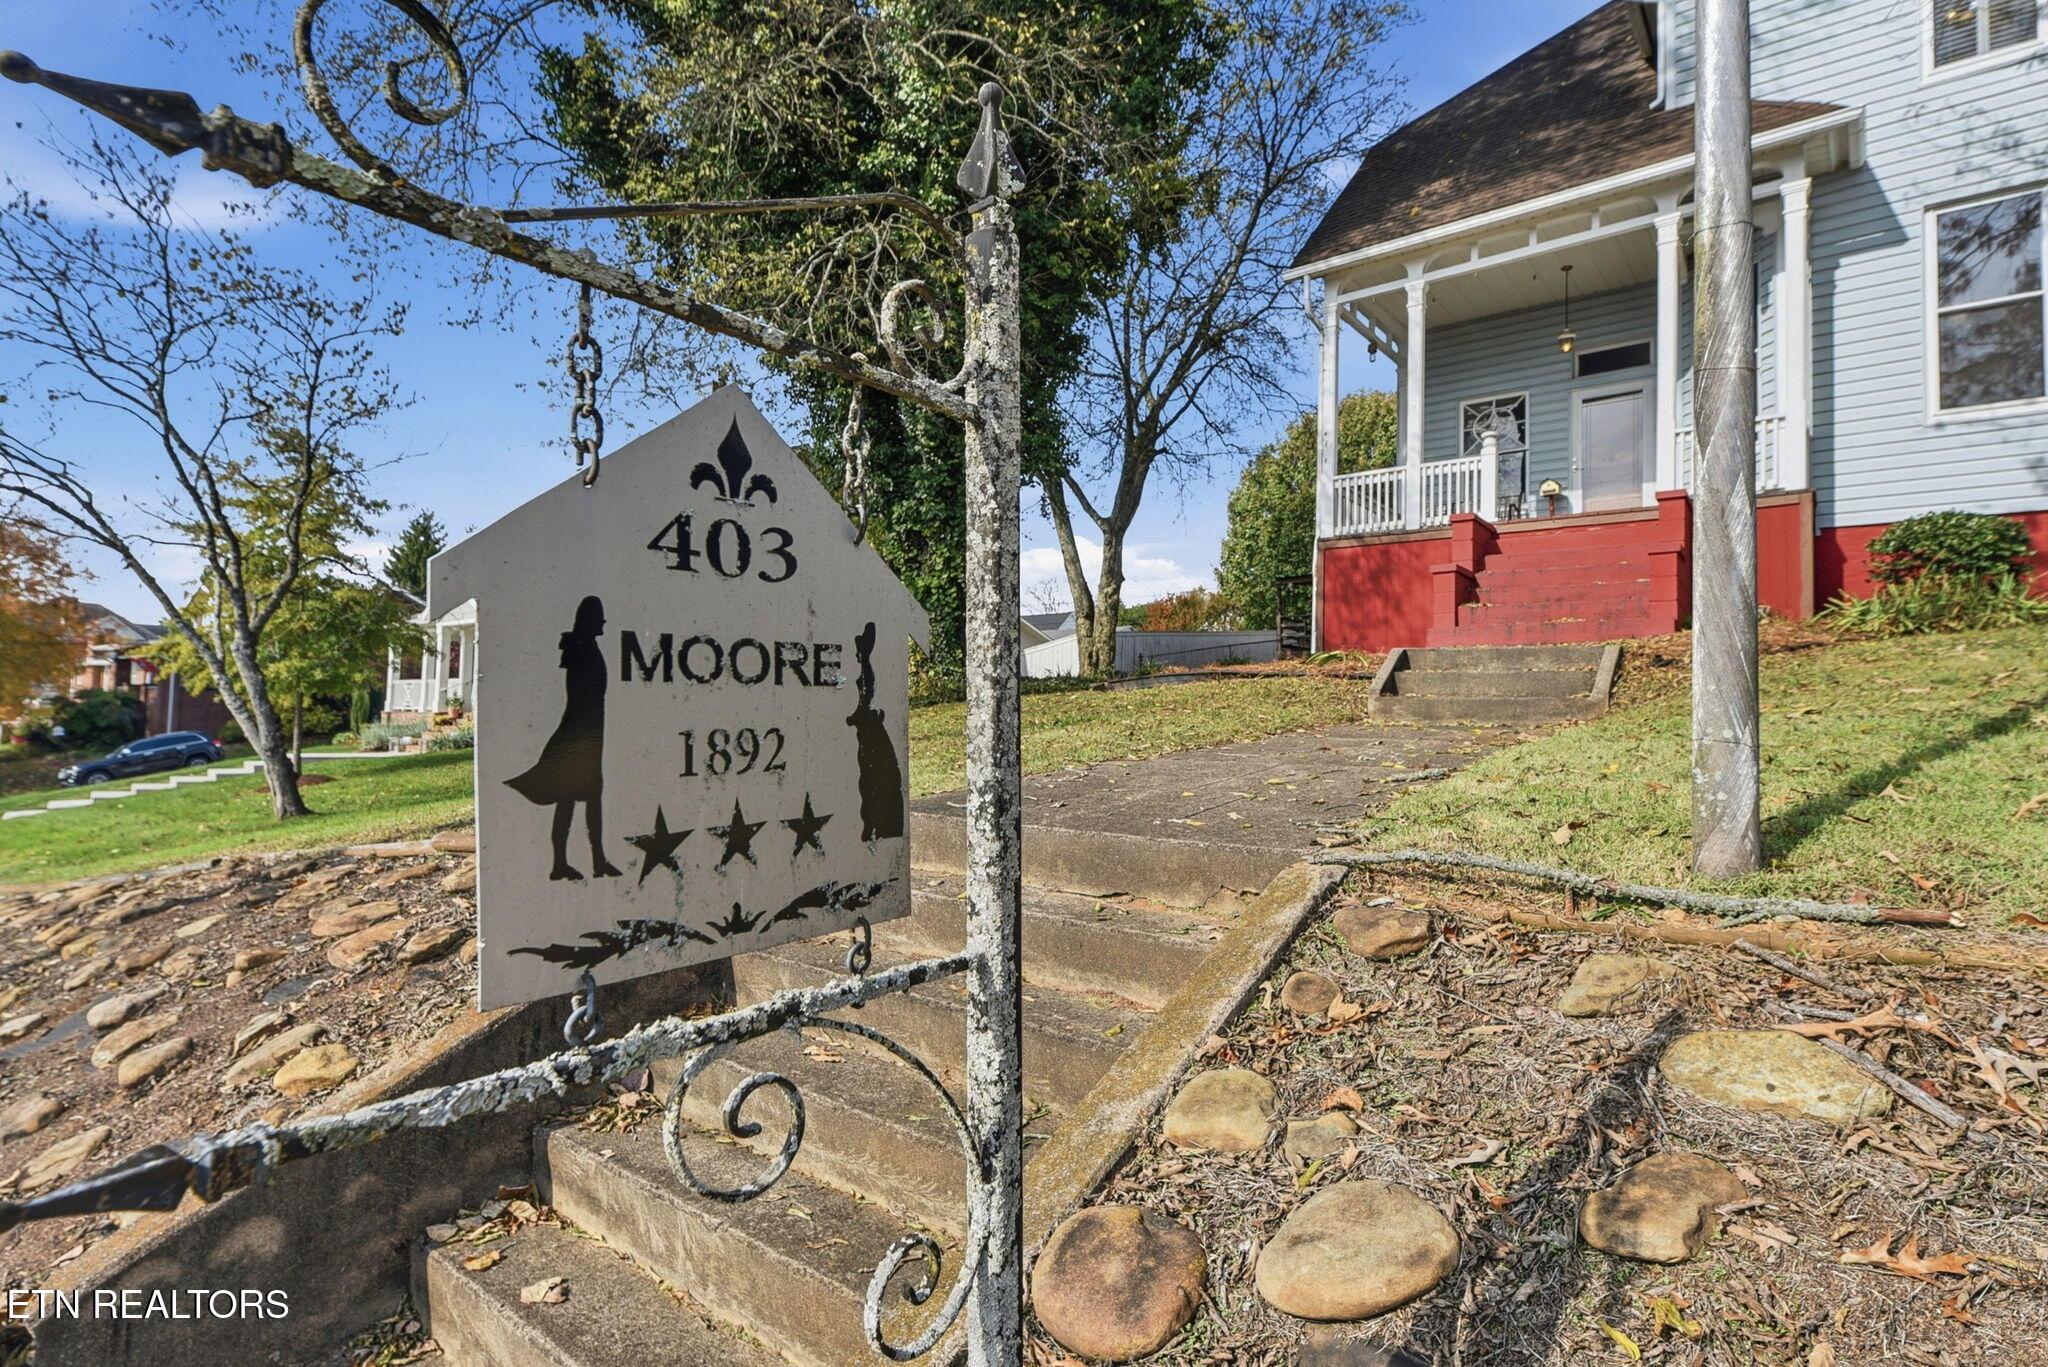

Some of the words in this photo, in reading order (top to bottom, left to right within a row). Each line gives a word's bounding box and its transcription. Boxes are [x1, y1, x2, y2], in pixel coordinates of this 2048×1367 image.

[647, 508, 798, 583] 403
[620, 630, 845, 688] MOORE
[678, 727, 787, 778] 1892
